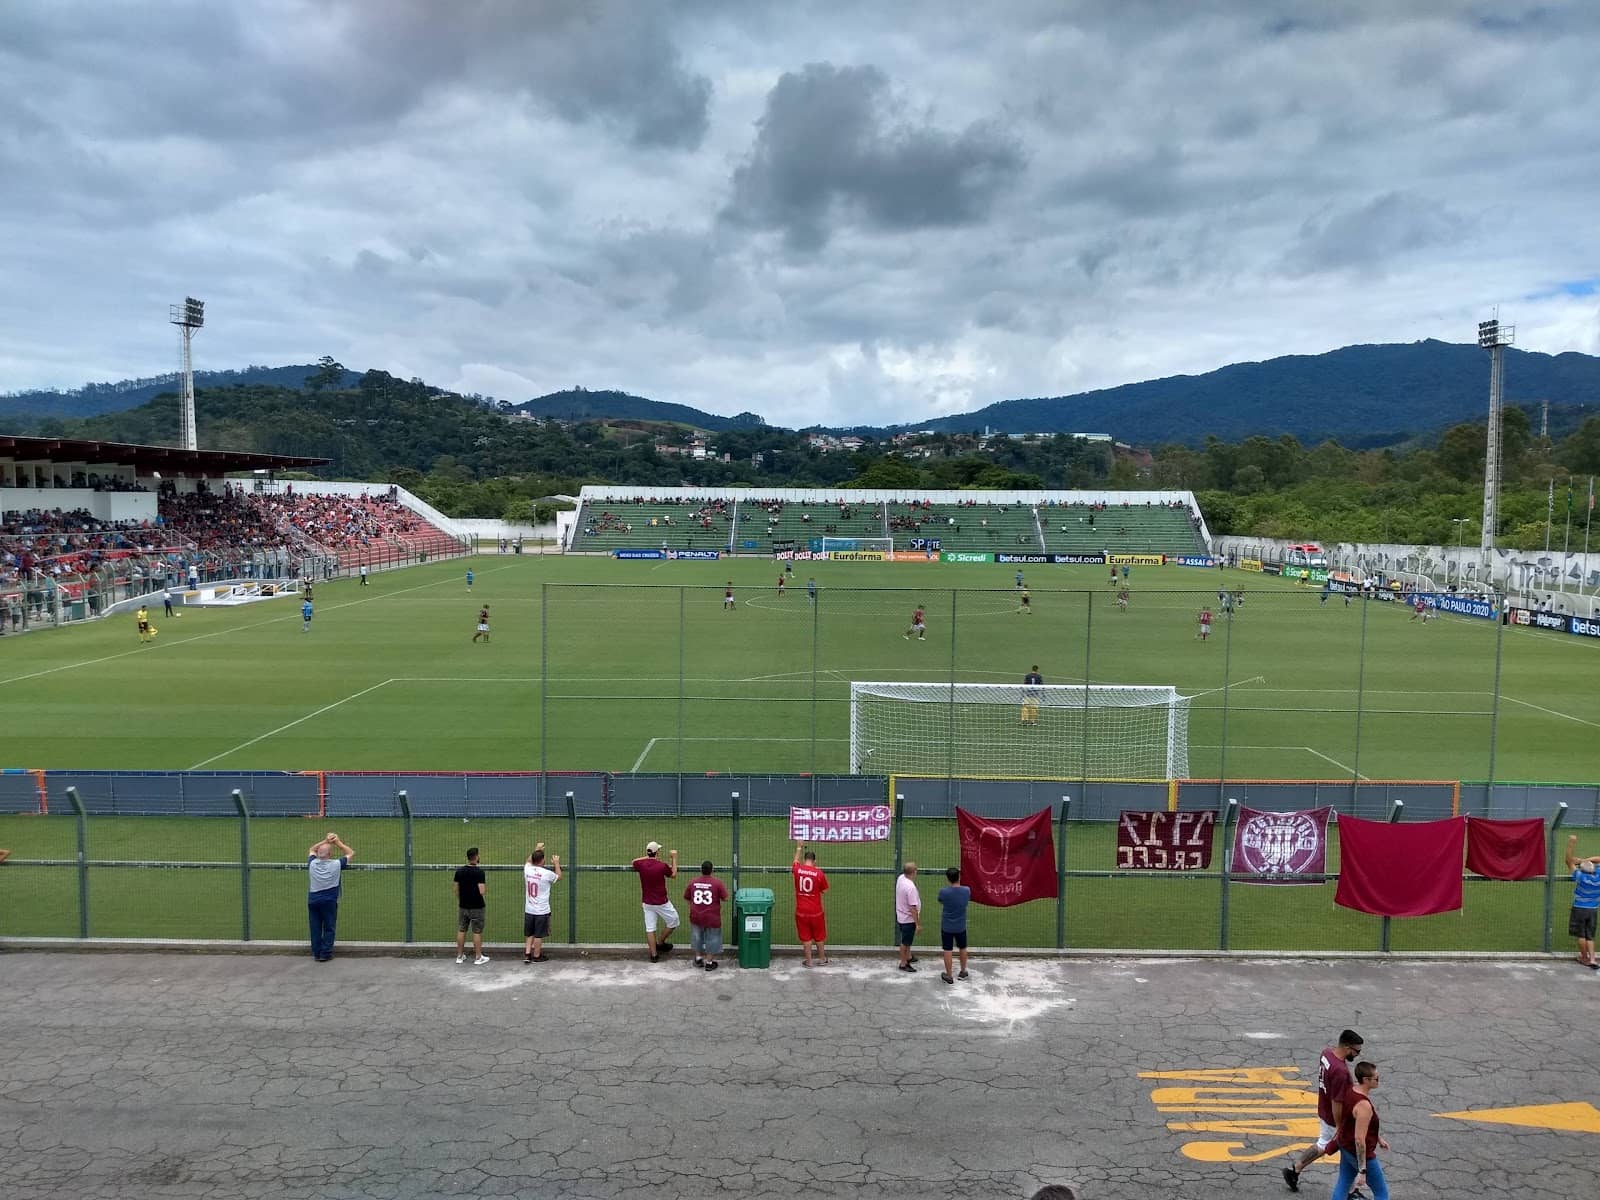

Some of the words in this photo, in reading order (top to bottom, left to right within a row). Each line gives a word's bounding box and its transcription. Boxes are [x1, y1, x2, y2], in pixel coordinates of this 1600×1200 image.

[776, 551, 794, 560] DOLLY
[794, 551, 813, 560] DOLLY
[833, 551, 882, 561] Eurofarma
[957, 553, 986, 562] Sicredi
[999, 554, 1047, 563] betsul.com
[1055, 555, 1104, 564] betsul.com
[1109, 555, 1159, 565] Eurofarma
[1450, 600, 1472, 613] PAULO
[1472, 604, 1489, 617] 2020
[527, 880, 538, 898] 10
[799, 876, 813, 893] 10
[693, 889, 713, 905] 83
